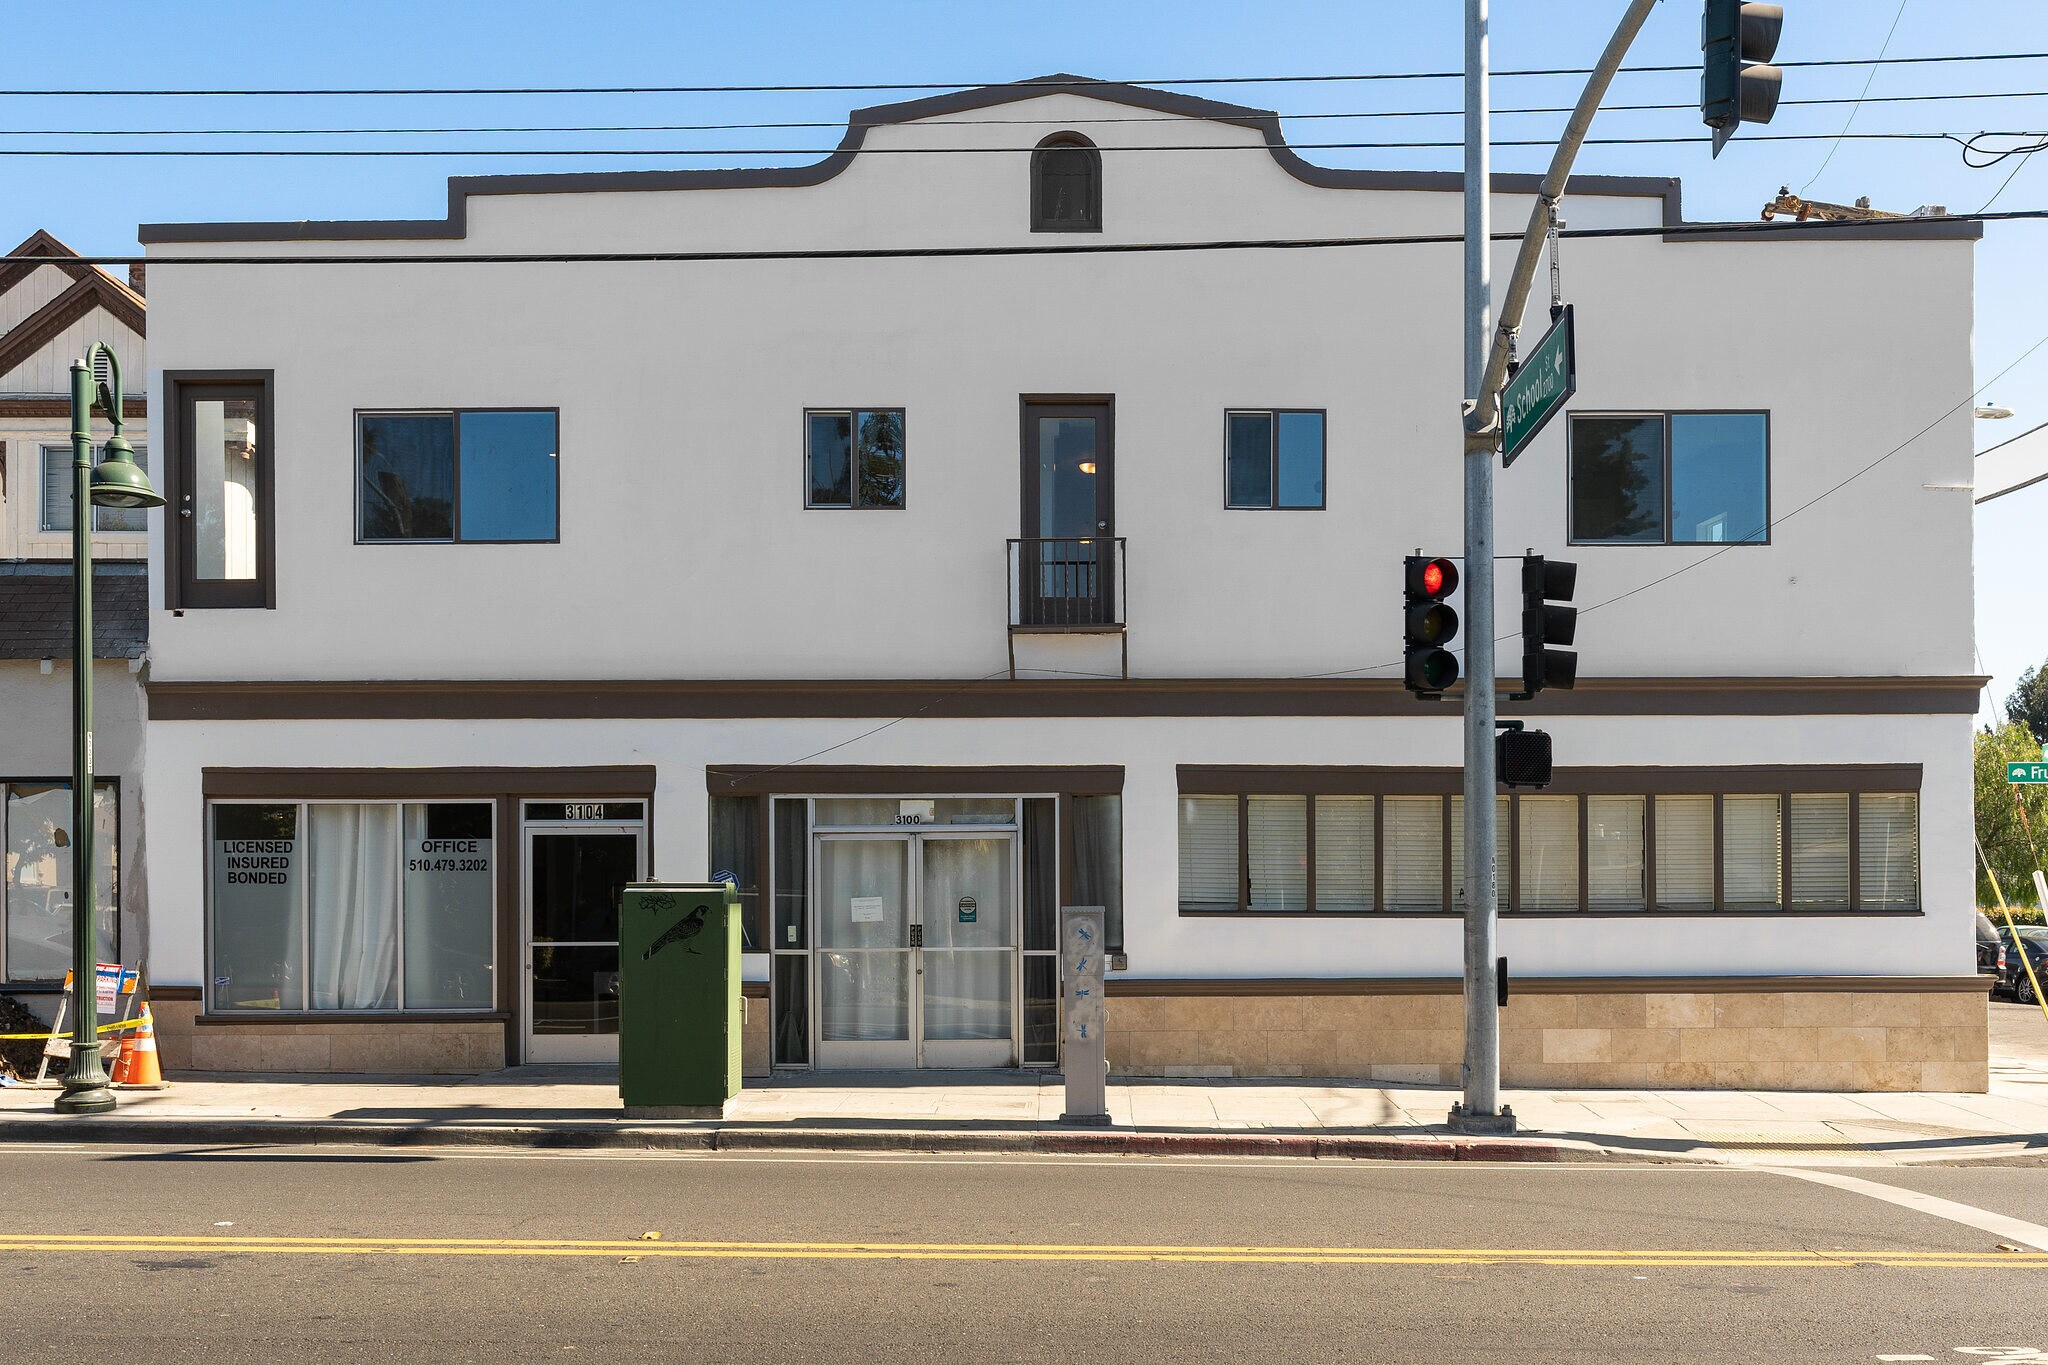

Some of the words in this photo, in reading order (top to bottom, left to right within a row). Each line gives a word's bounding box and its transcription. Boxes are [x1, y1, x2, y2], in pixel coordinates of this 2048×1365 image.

[1517, 368, 1542, 424] School
[566, 805, 602, 819] 3104
[895, 815, 920, 825] 3100
[223, 841, 293, 853] LICENSED
[421, 840, 477, 853] OFFICE
[227, 857, 289, 869] INSURED
[409, 859, 488, 872] 510.479.3202
[228, 872, 287, 884] BONDED
